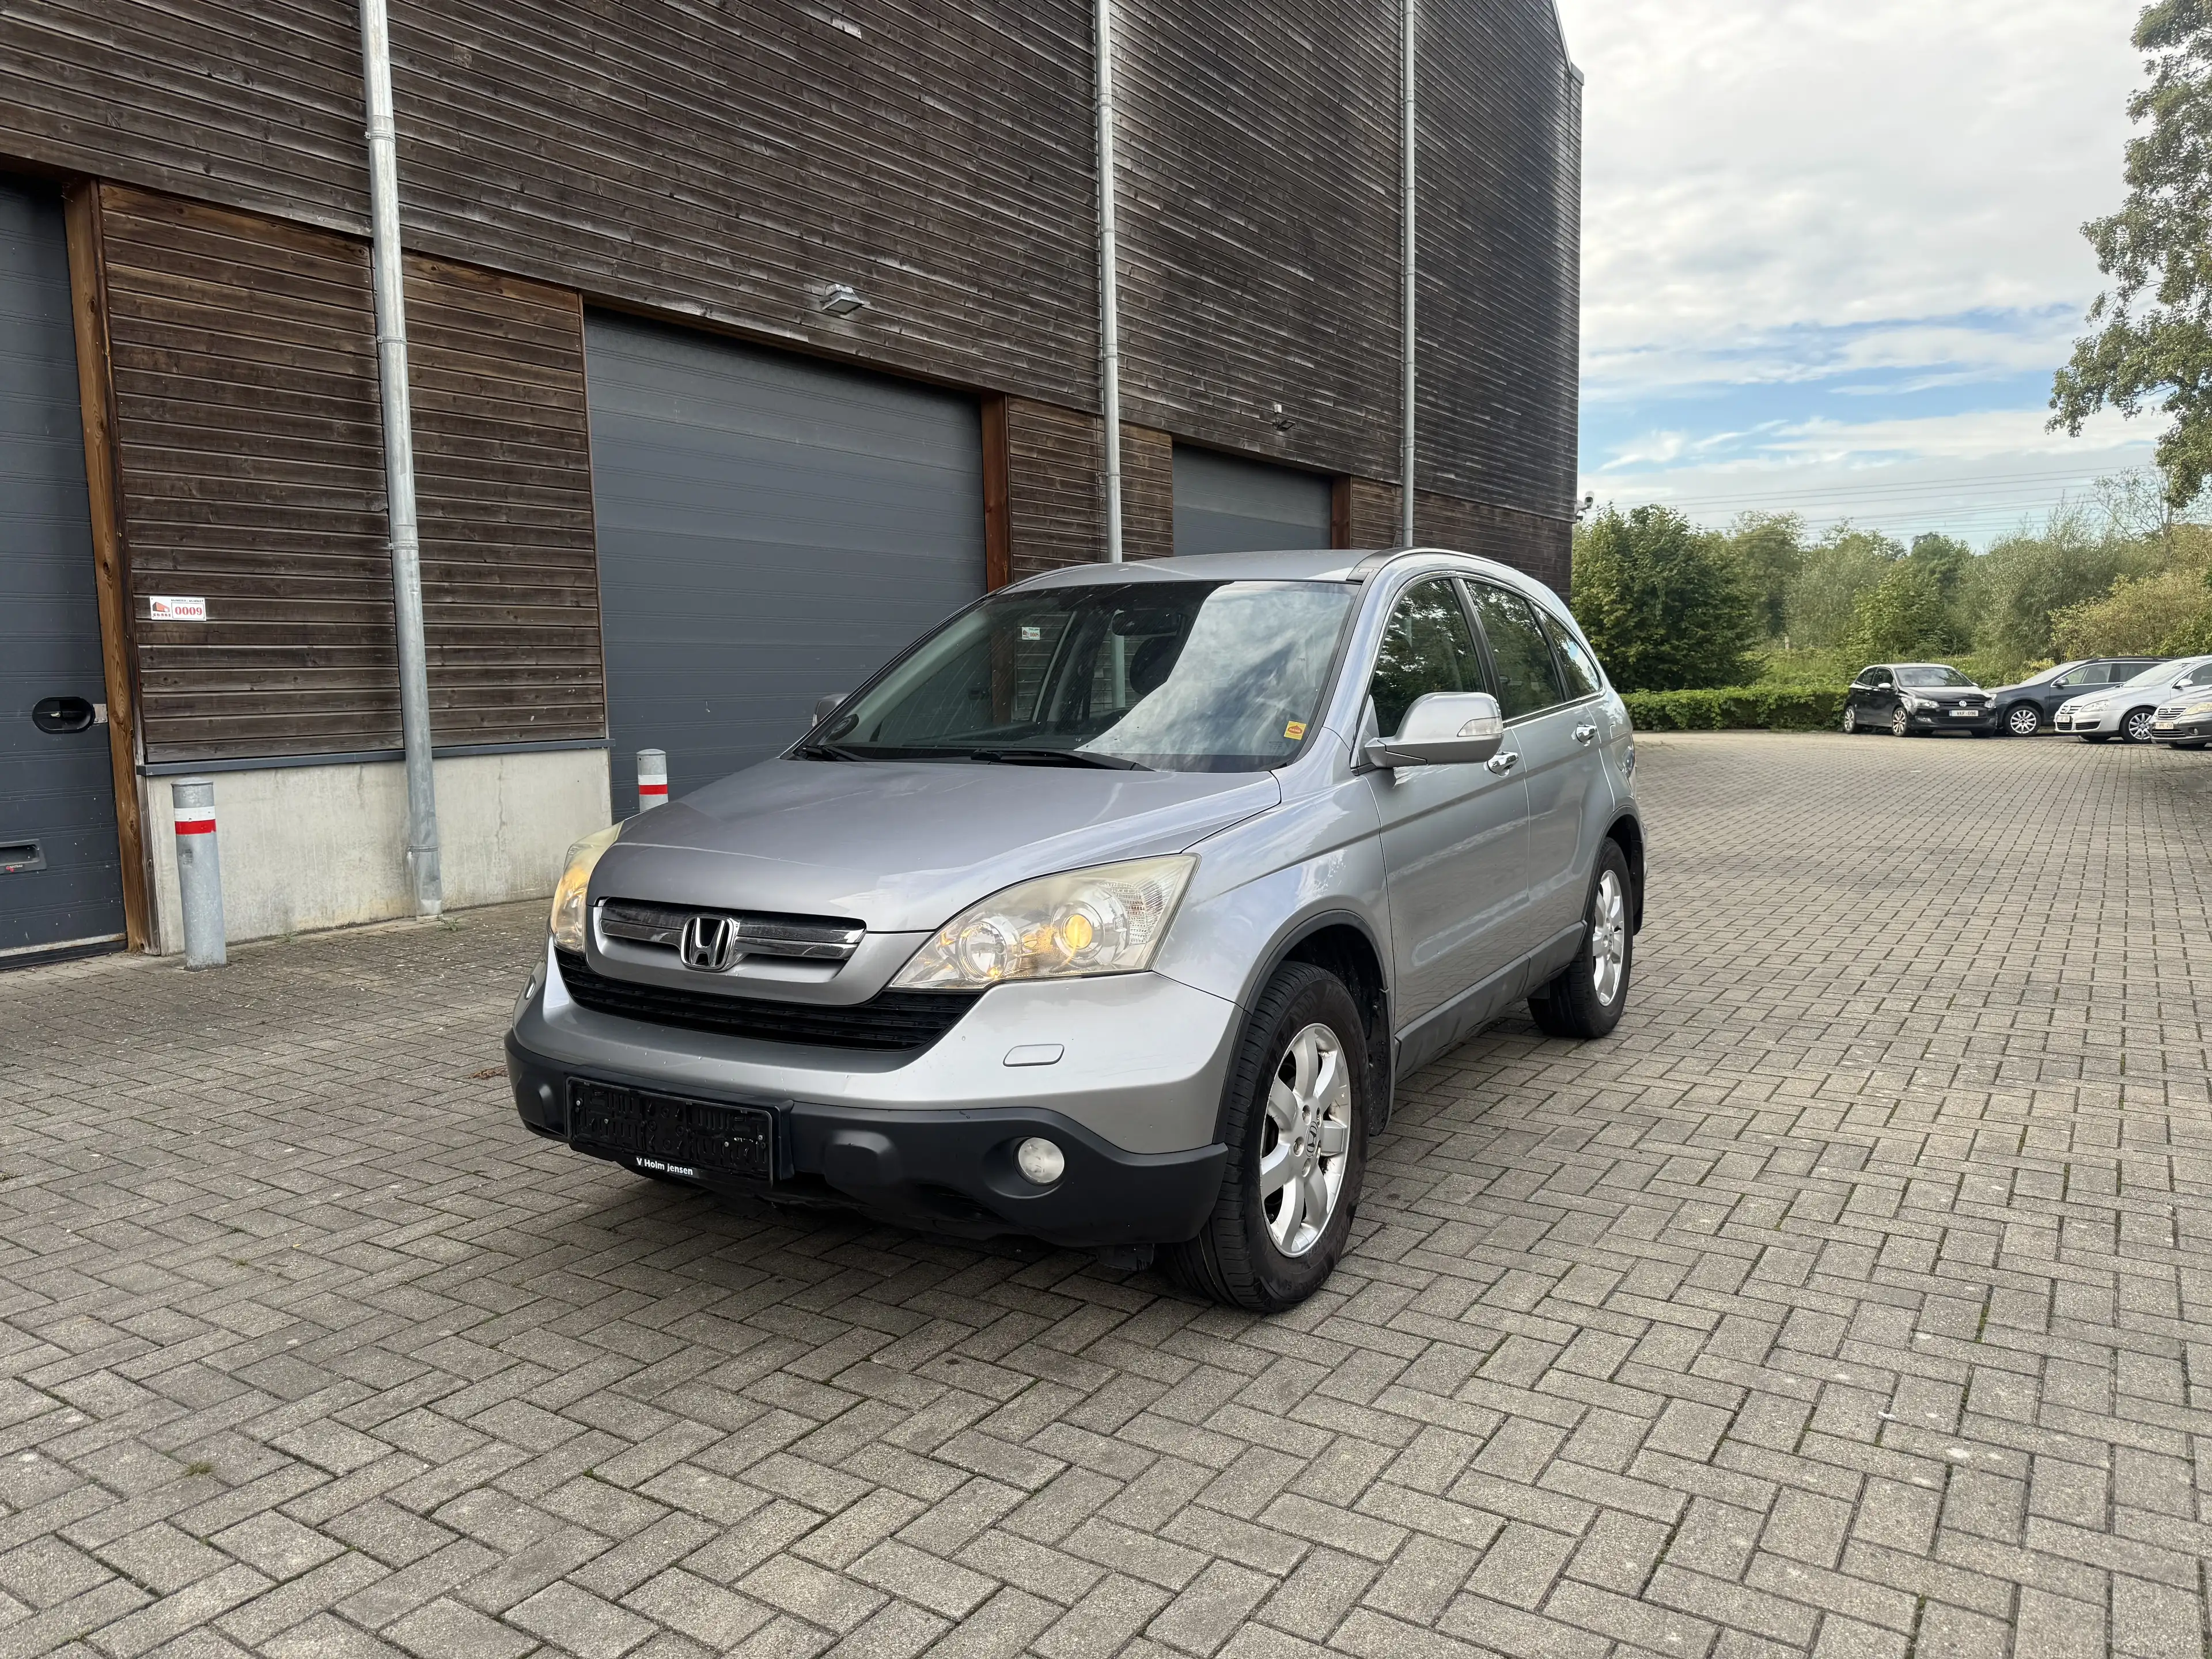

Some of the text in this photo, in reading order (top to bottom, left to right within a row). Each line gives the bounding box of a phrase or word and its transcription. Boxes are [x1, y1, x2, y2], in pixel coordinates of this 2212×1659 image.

[175, 607, 203, 615] 0009
[636, 1157, 643, 1166] V
[644, 1158, 665, 1171] Holm
